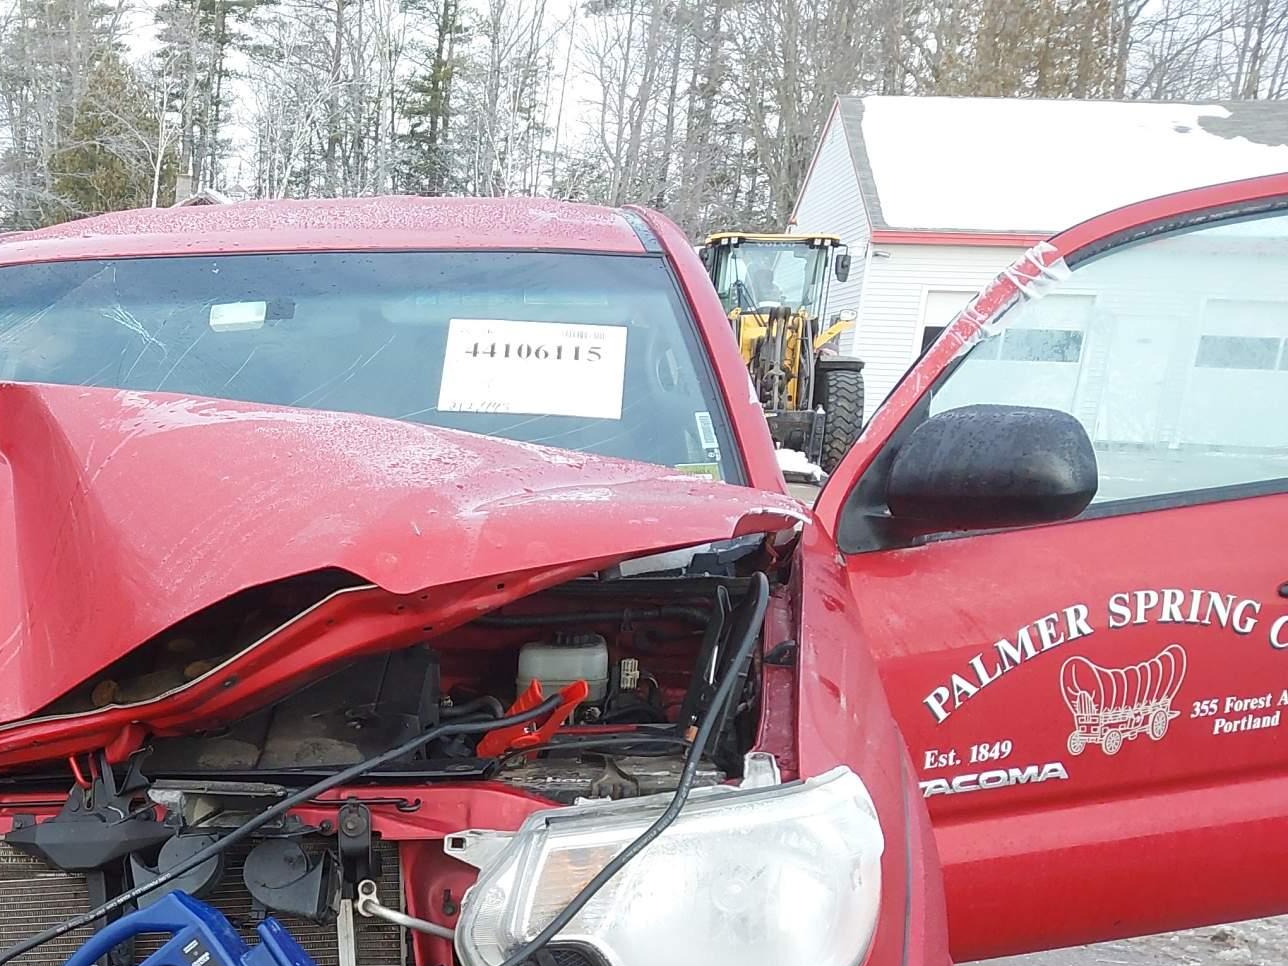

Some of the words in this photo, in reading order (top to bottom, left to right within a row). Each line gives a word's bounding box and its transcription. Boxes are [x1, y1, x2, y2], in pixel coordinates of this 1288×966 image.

[464, 341, 602, 363] 44106115
[922, 603, 1095, 724] PALMER
[1107, 588, 1262, 634] SPRING
[1190, 698, 1220, 719] 355
[1223, 692, 1273, 714] Forest
[1212, 710, 1281, 735] Portland
[923, 749, 962, 770] Est.
[968, 740, 1013, 763] 1849
